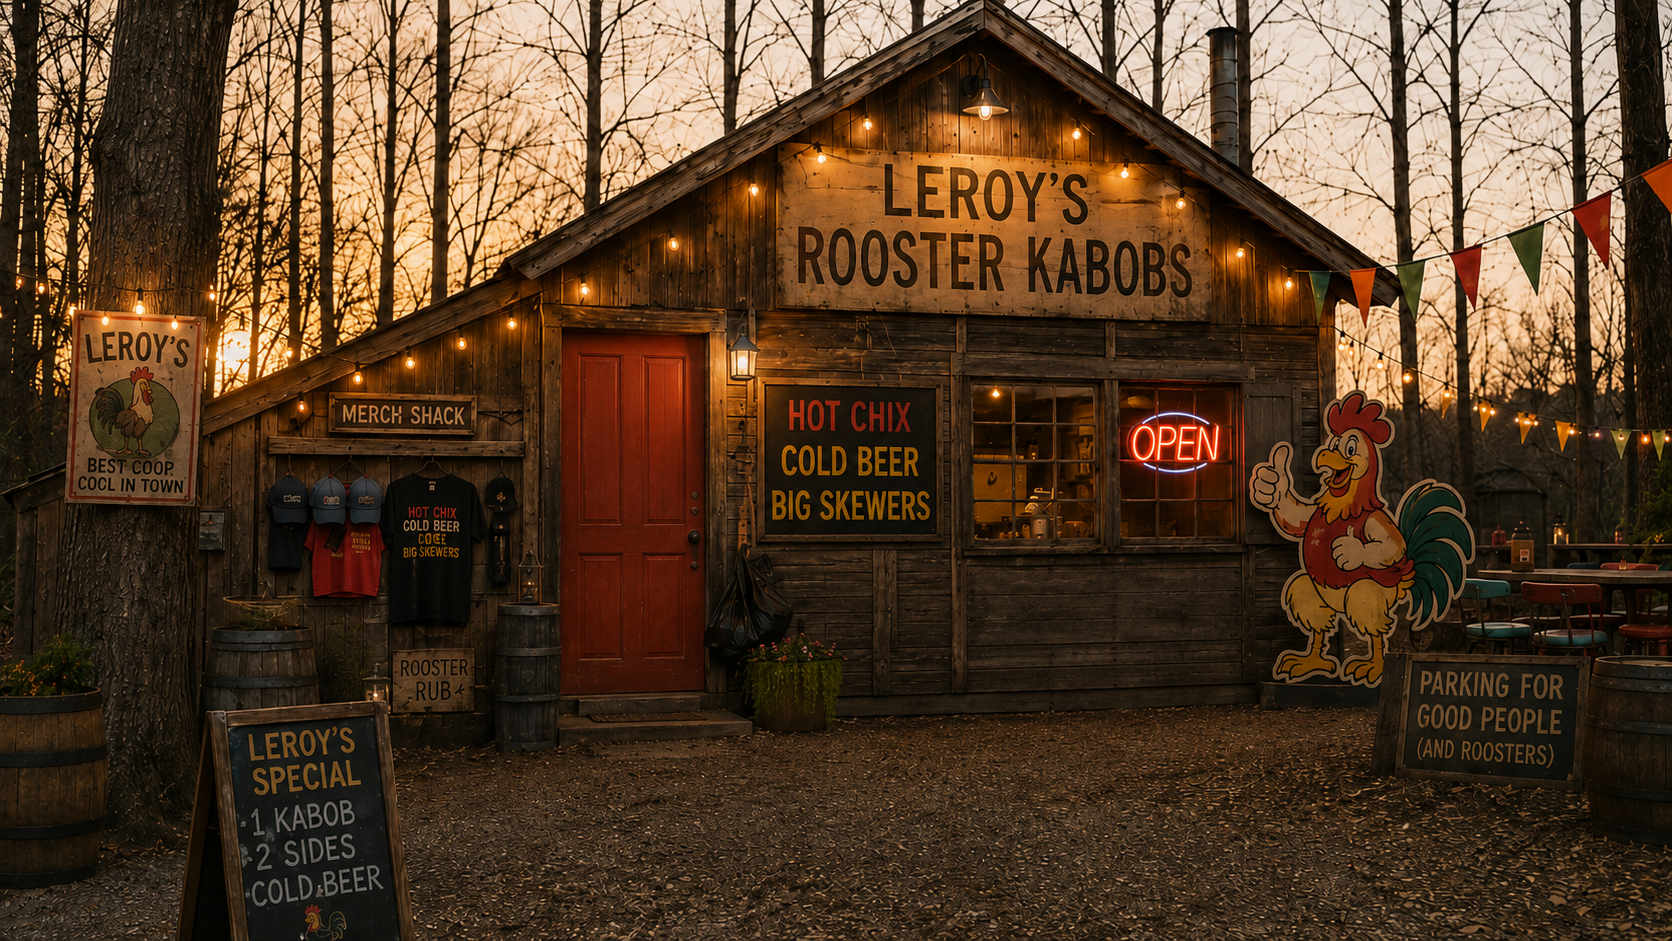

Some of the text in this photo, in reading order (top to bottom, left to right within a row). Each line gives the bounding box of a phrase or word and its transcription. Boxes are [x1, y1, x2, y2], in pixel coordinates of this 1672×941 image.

[884, 164, 1088, 225] LEROY'S
[798, 226, 1192, 298] ROOSTER KABOBS
[85, 331, 190, 368] LEROY'S
[342, 404, 465, 426] MERCH SHACK
[788, 399, 912, 433] HOT CHIX
[1132, 424, 1220, 462] OPEN
[87, 457, 127, 474] BEST
[781, 444, 920, 477] COLD BEER
[120, 478, 135, 492] IN
[141, 478, 184, 493] TOWN
[408, 506, 457, 520] HOT CHIX
[771, 489, 931, 521] BIG SKEWERS
[403, 519, 460, 533] COLD BEER
[403, 545, 460, 559] BIG SKEWERS
[400, 658, 469, 677] ROOSTER
[416, 680, 452, 702] RUB
[1419, 670, 1564, 700] PARKING FOR
[1417, 703, 1562, 735] GOOD PEOPLE
[248, 726, 356, 762] LEROY'S
[1416, 737, 1555, 769] (AND ROOSTERS)
[252, 759, 362, 796] SPECIAL
[250, 799, 356, 837] 1 KABOB
[256, 833, 356, 871] 2 SIDES
[251, 864, 384, 907] COLD BEER
